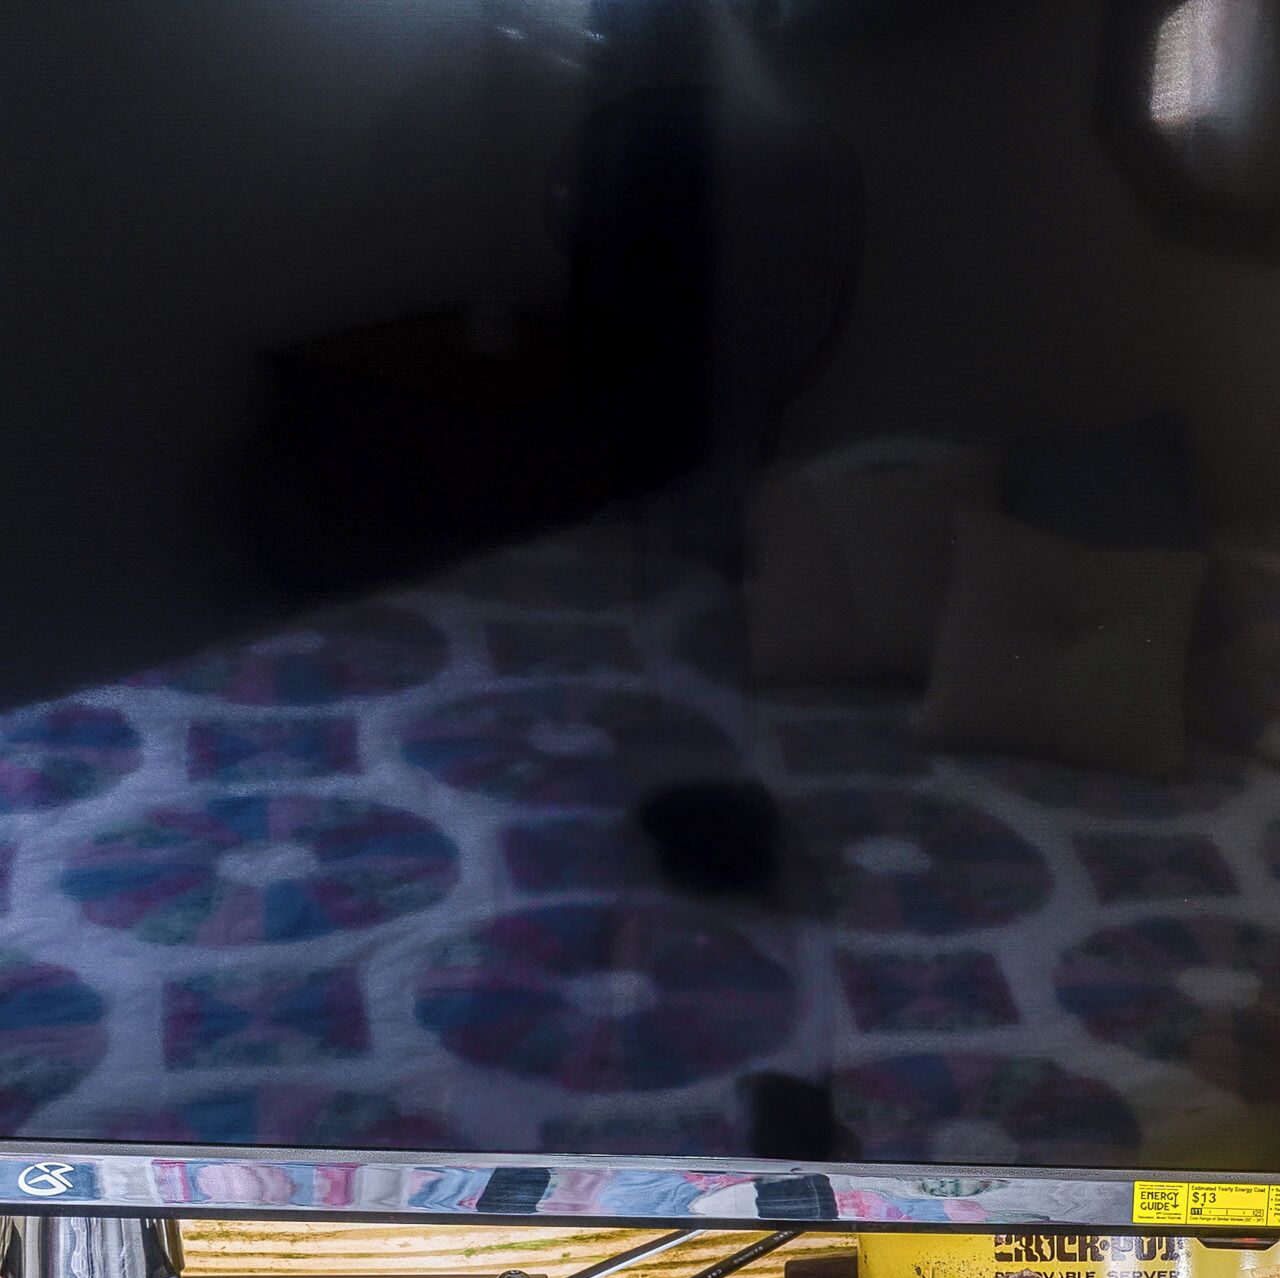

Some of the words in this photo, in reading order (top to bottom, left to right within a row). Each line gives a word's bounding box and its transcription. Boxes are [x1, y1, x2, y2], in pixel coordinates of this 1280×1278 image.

[1140, 1191, 1180, 1201] ENERGY
[1191, 1191, 1217, 1204] $13
[1140, 1202, 1170, 1211] GUIDE
